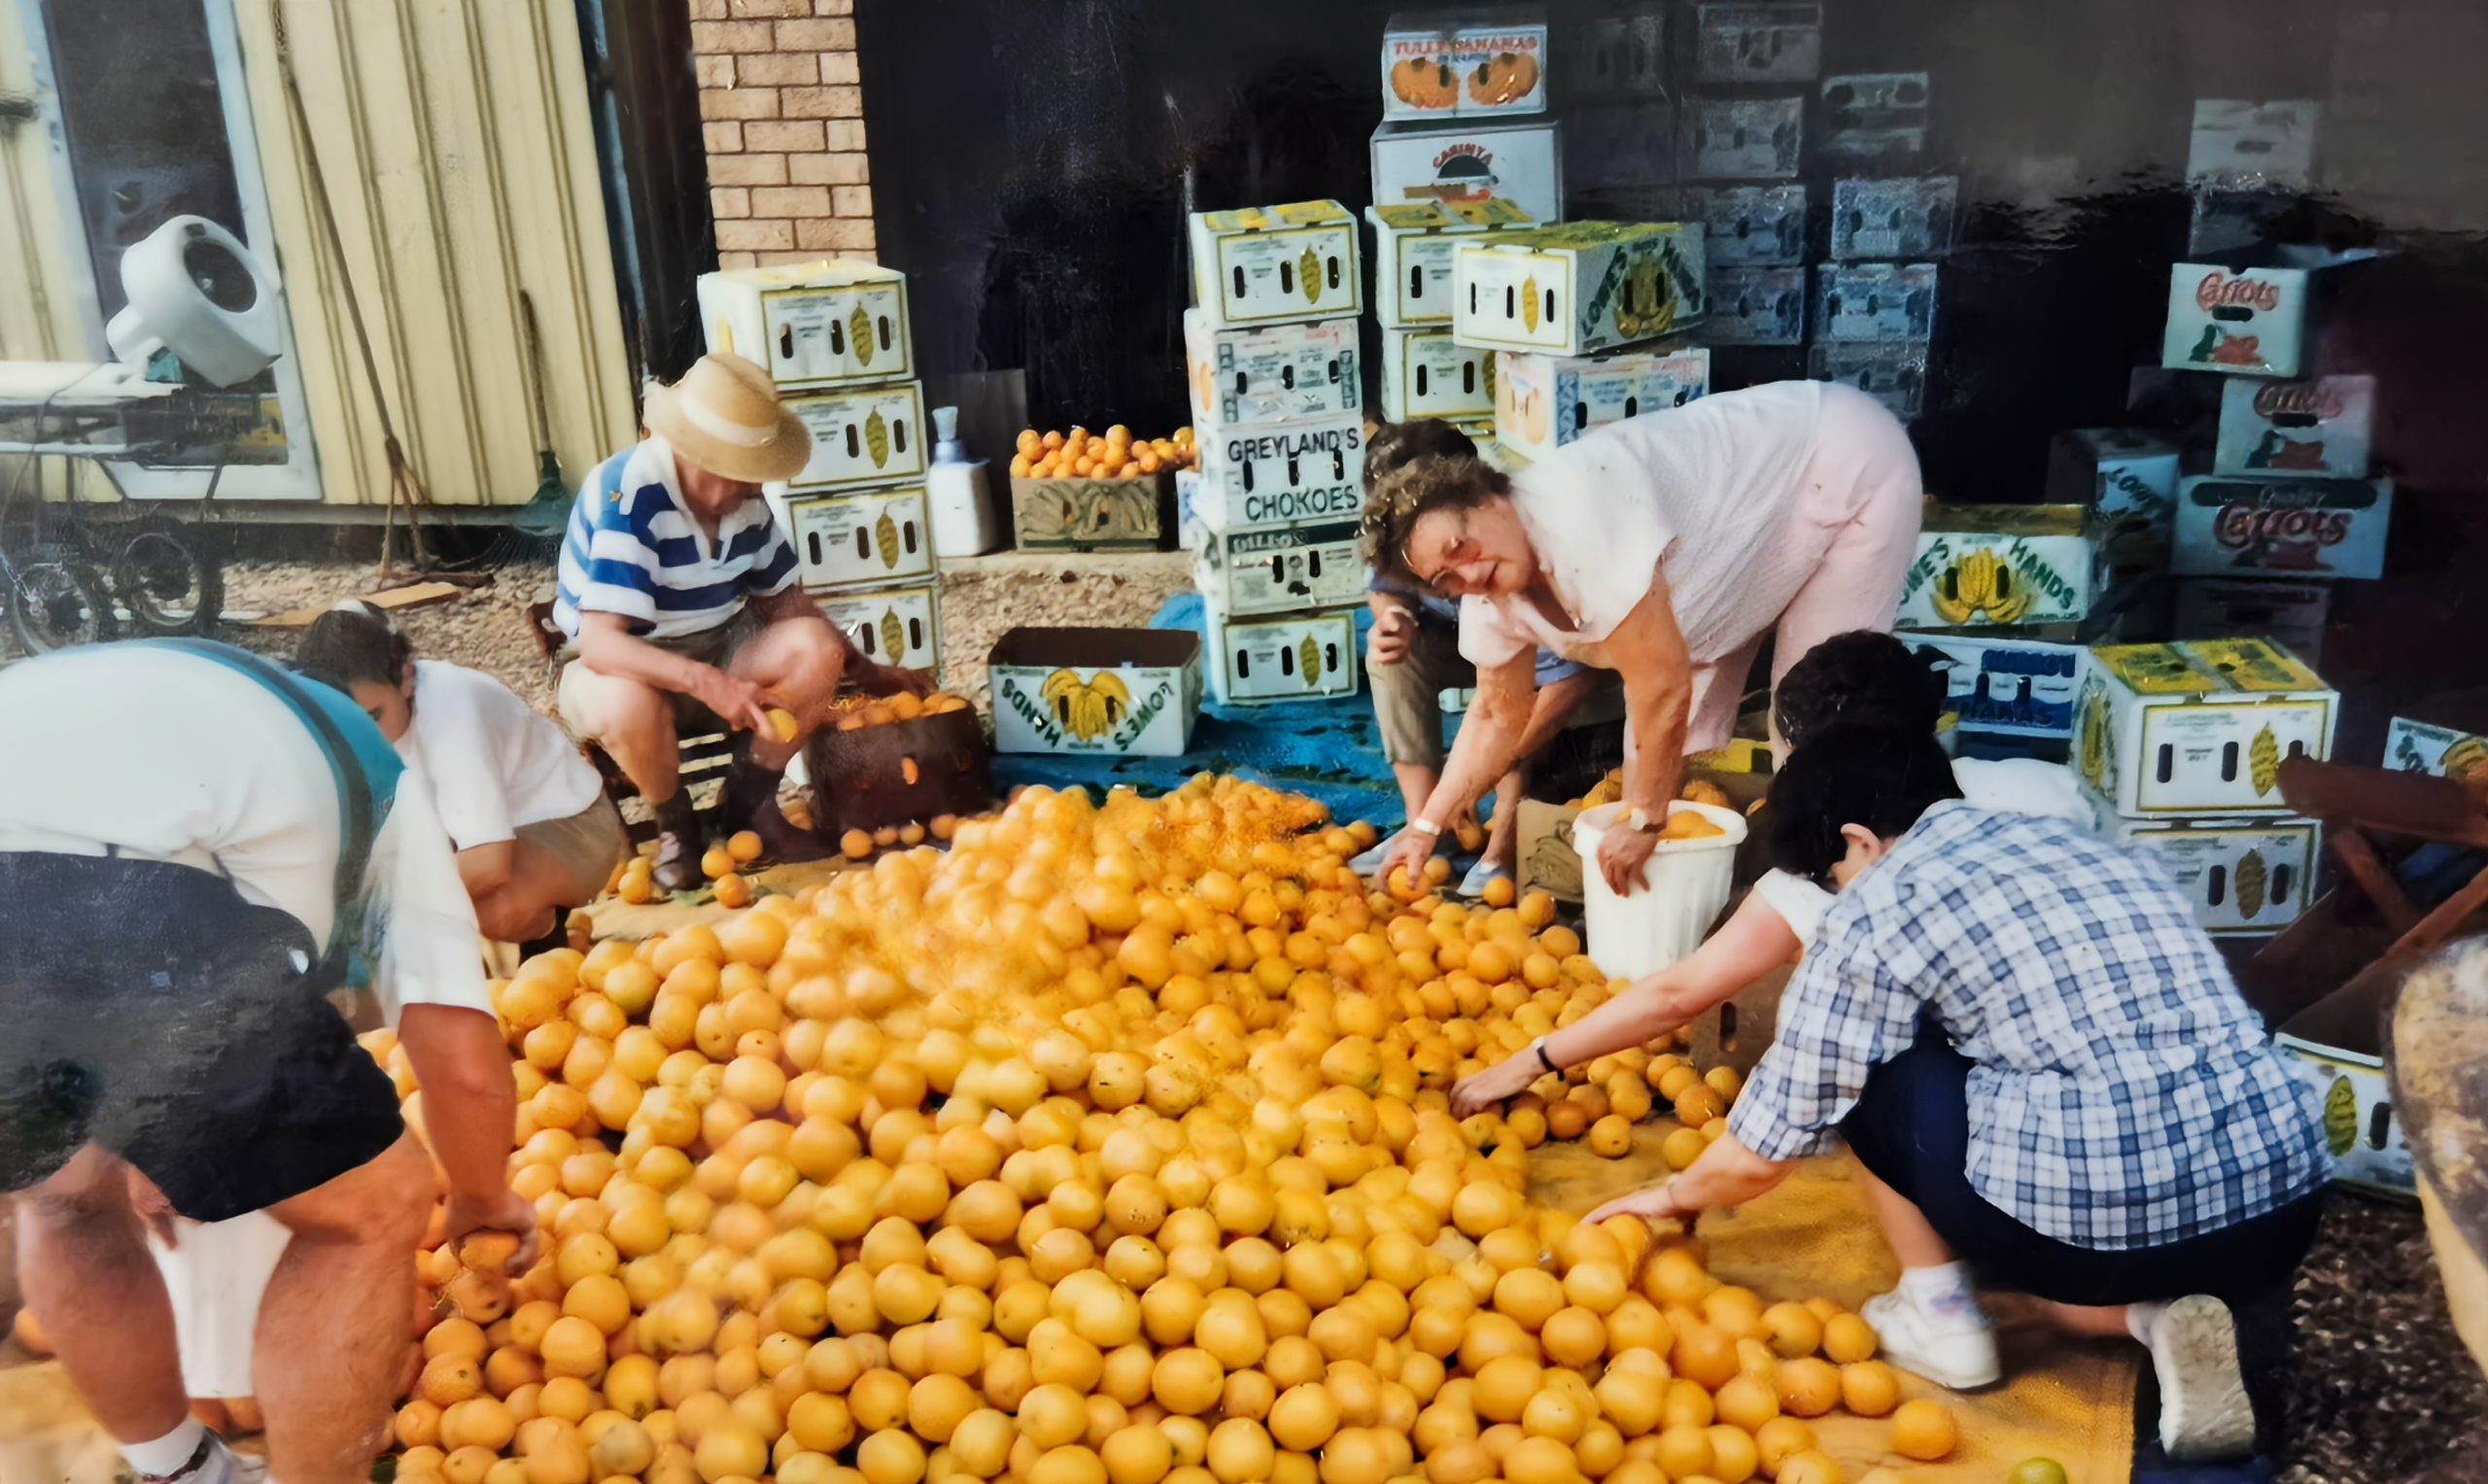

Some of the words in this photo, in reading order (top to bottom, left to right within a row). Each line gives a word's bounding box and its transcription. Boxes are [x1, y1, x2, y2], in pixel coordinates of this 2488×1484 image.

[1227, 428, 1360, 463] GREYLAND'S
[1246, 485, 1359, 521] CHOKOES
[2010, 536, 2075, 609] HANDS
